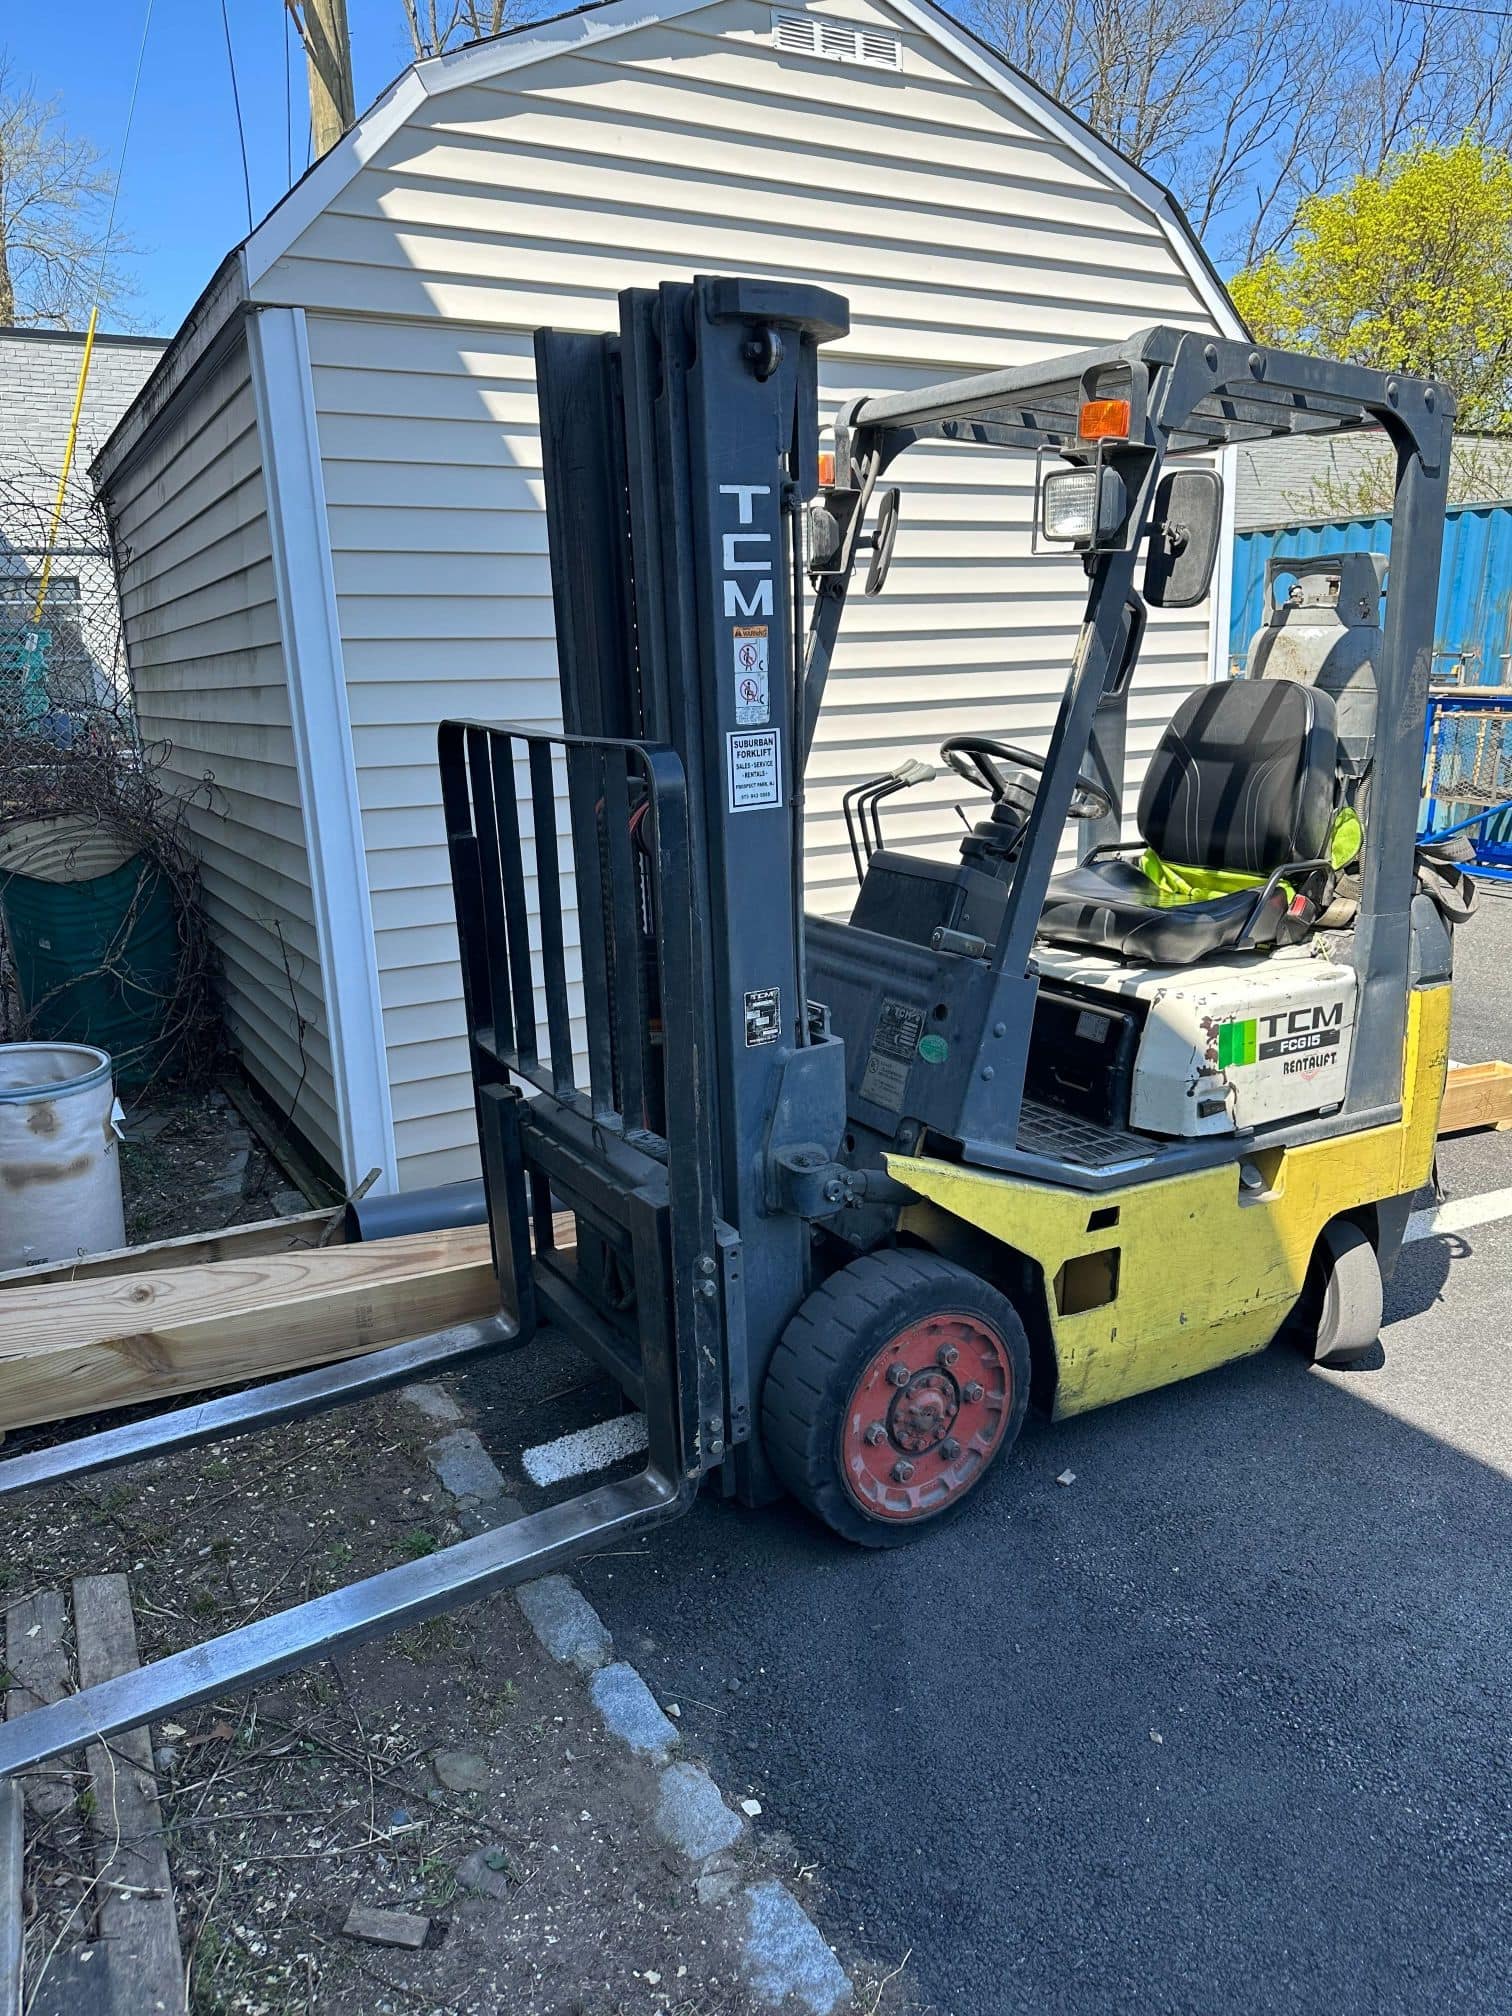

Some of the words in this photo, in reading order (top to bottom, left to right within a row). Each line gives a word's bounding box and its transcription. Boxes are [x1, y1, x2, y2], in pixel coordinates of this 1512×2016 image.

[719, 484, 774, 617] TCM
[734, 738, 774, 749] SUBURBAN
[737, 748, 772, 759] FORKLIFT
[1259, 1003, 1343, 1037] TCM
[1280, 1034, 1321, 1053] FCG15
[1283, 1052, 1337, 1075] RENTALIFT
